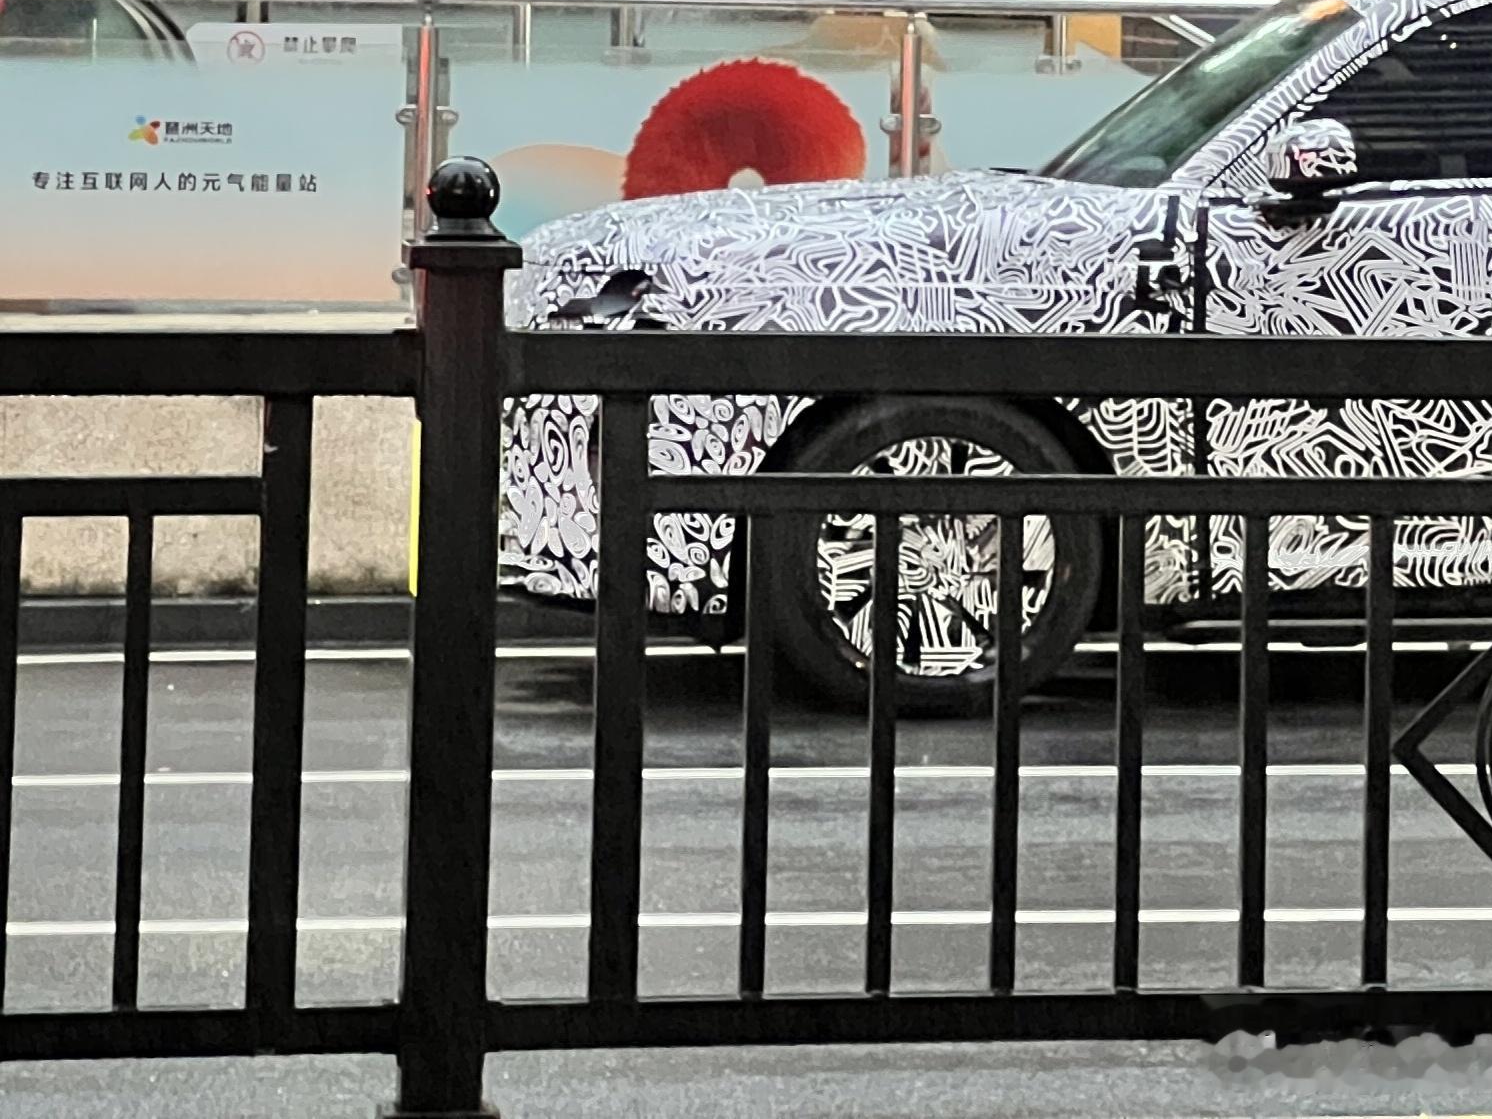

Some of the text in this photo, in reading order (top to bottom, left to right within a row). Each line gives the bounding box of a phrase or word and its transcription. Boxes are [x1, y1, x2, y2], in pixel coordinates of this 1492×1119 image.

[32, 171, 318, 193] 专注互联网人的元气能量站
